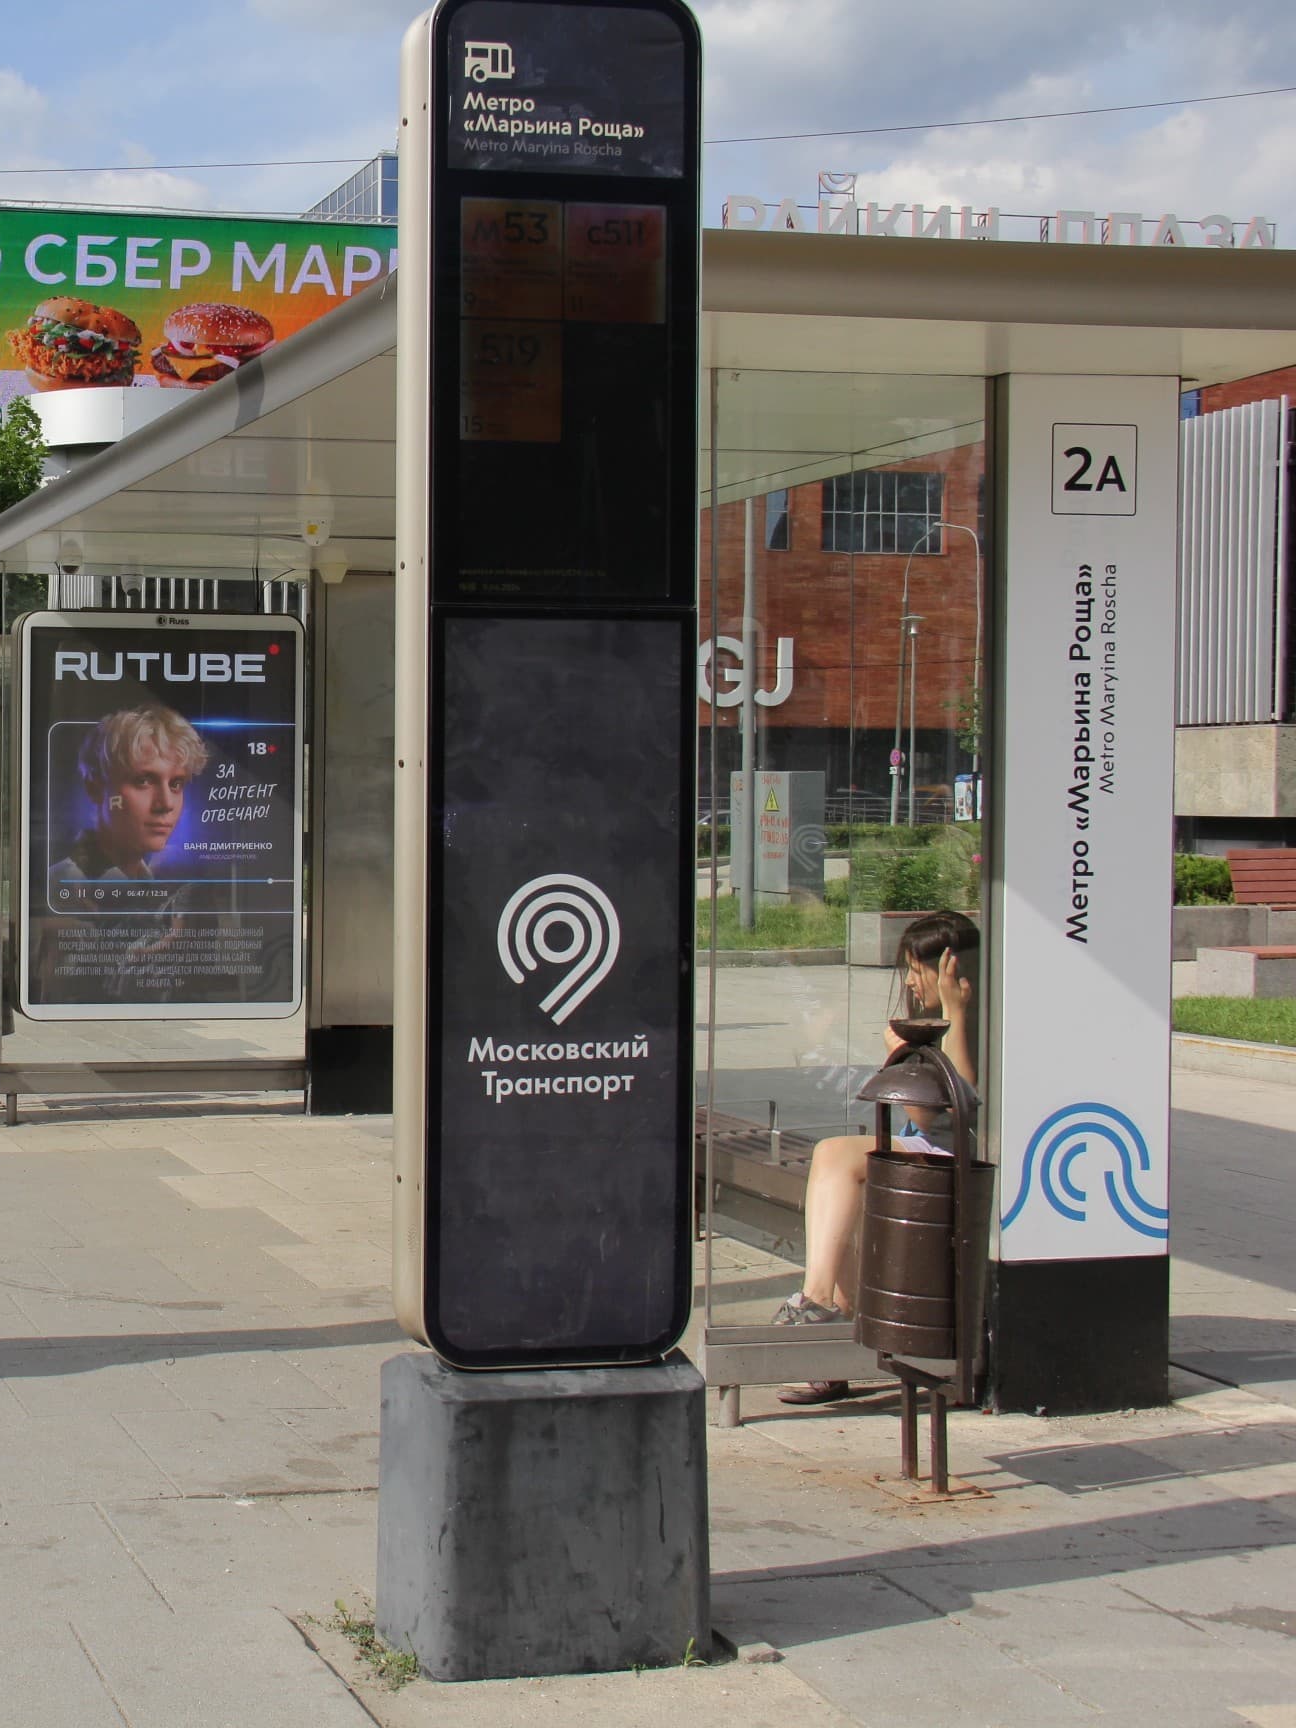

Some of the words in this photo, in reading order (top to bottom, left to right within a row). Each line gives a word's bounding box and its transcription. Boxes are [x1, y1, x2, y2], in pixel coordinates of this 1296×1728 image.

[463, 92, 536, 115] Метро
[463, 114, 572, 136] «Марьина
[578, 118, 645, 139] Роща»
[464, 138, 508, 153] Metro
[512, 139, 569, 156] Maryina
[574, 141, 623, 157] Roscha
[24, 233, 212, 289] СБЕР
[1064, 446, 1127, 492] 2А
[1069, 564, 1096, 660] Роща»
[1101, 564, 1117, 634] Roscha
[169, 617, 190, 626] Russ
[55, 651, 266, 683] RUTUBE
[1099, 641, 1119, 727] Maryina
[247, 742, 277, 755] 18+
[1067, 673, 1096, 830] «Марьина
[1099, 732, 1115, 794] Metro
[216, 764, 236, 779] ЗА
[208, 783, 277, 801] КОНТЕНТ
[201, 804, 271, 823] ОТВЕЧАЮ!
[183, 842, 208, 850] ВАНЯ
[209, 842, 273, 851] ДМИТРИЕНКО
[1066, 841, 1094, 944] Метро
[467, 1034, 649, 1062] Московский
[481, 1071, 635, 1103] Транспорт
